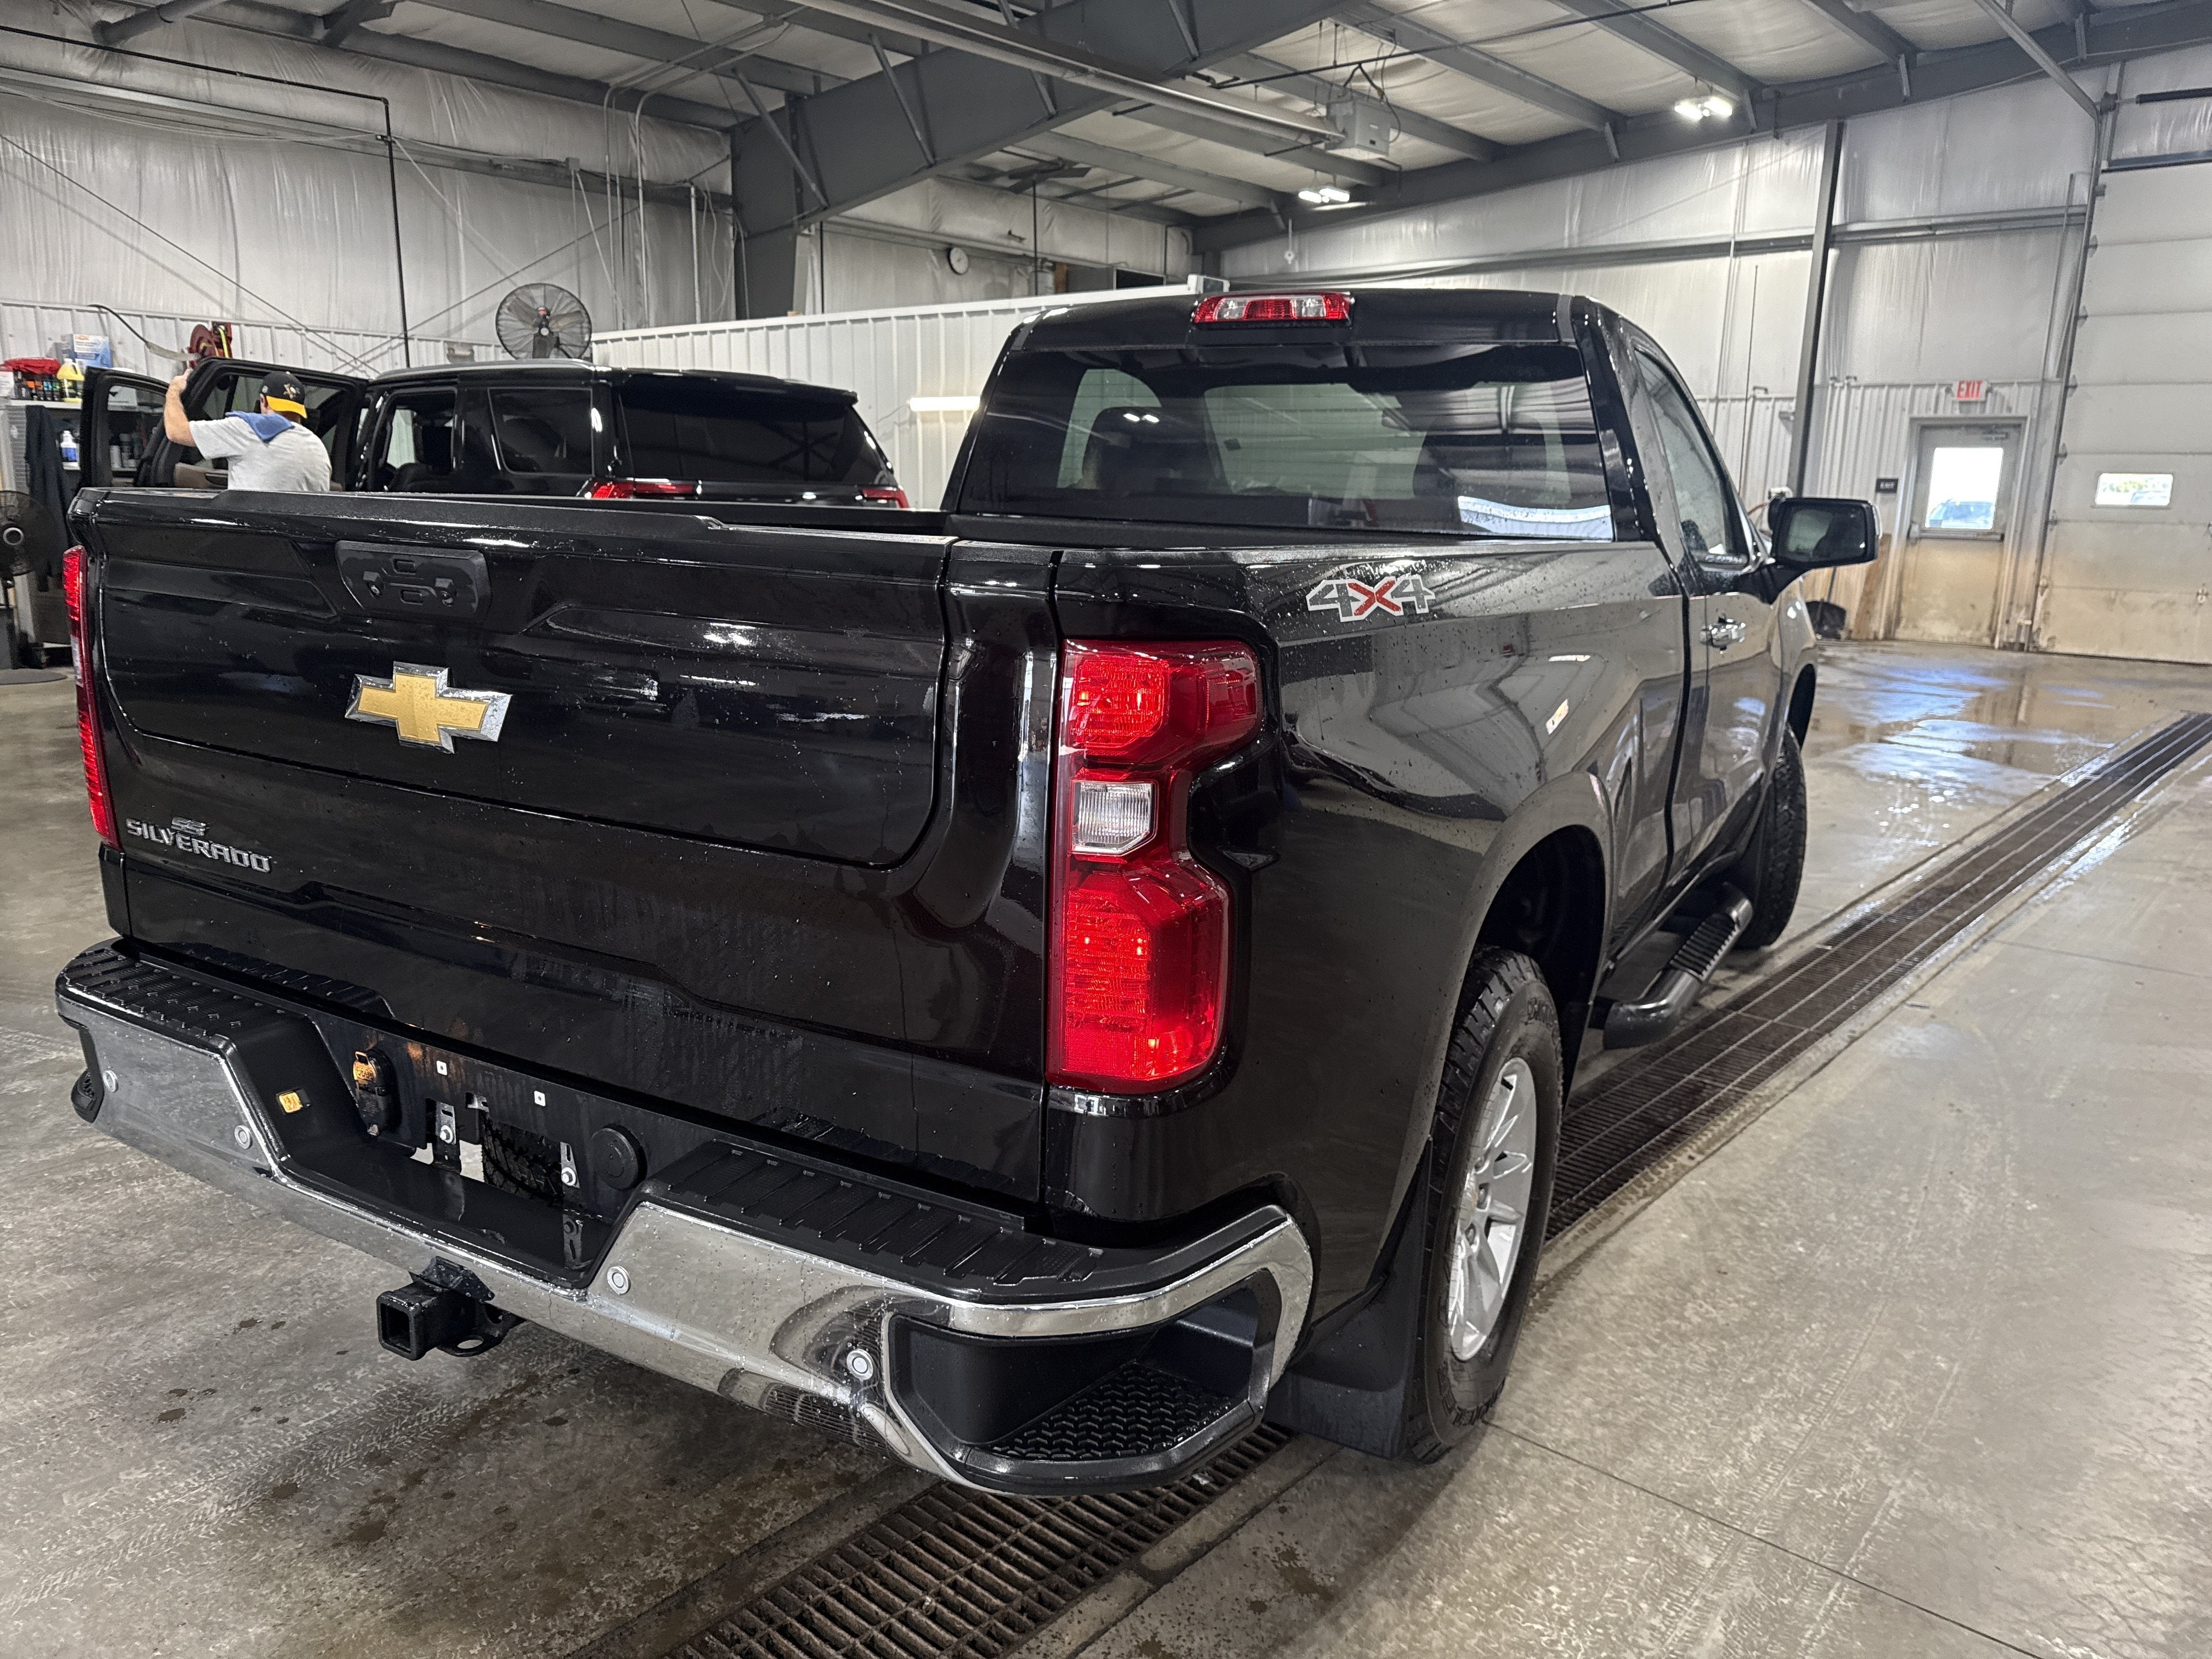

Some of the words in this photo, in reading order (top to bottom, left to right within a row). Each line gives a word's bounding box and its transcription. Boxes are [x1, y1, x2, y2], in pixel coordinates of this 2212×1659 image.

[1957, 380, 1983, 398] EXIT
[1306, 574, 1436, 622] 4X4
[126, 818, 272, 873] SILVERADO
